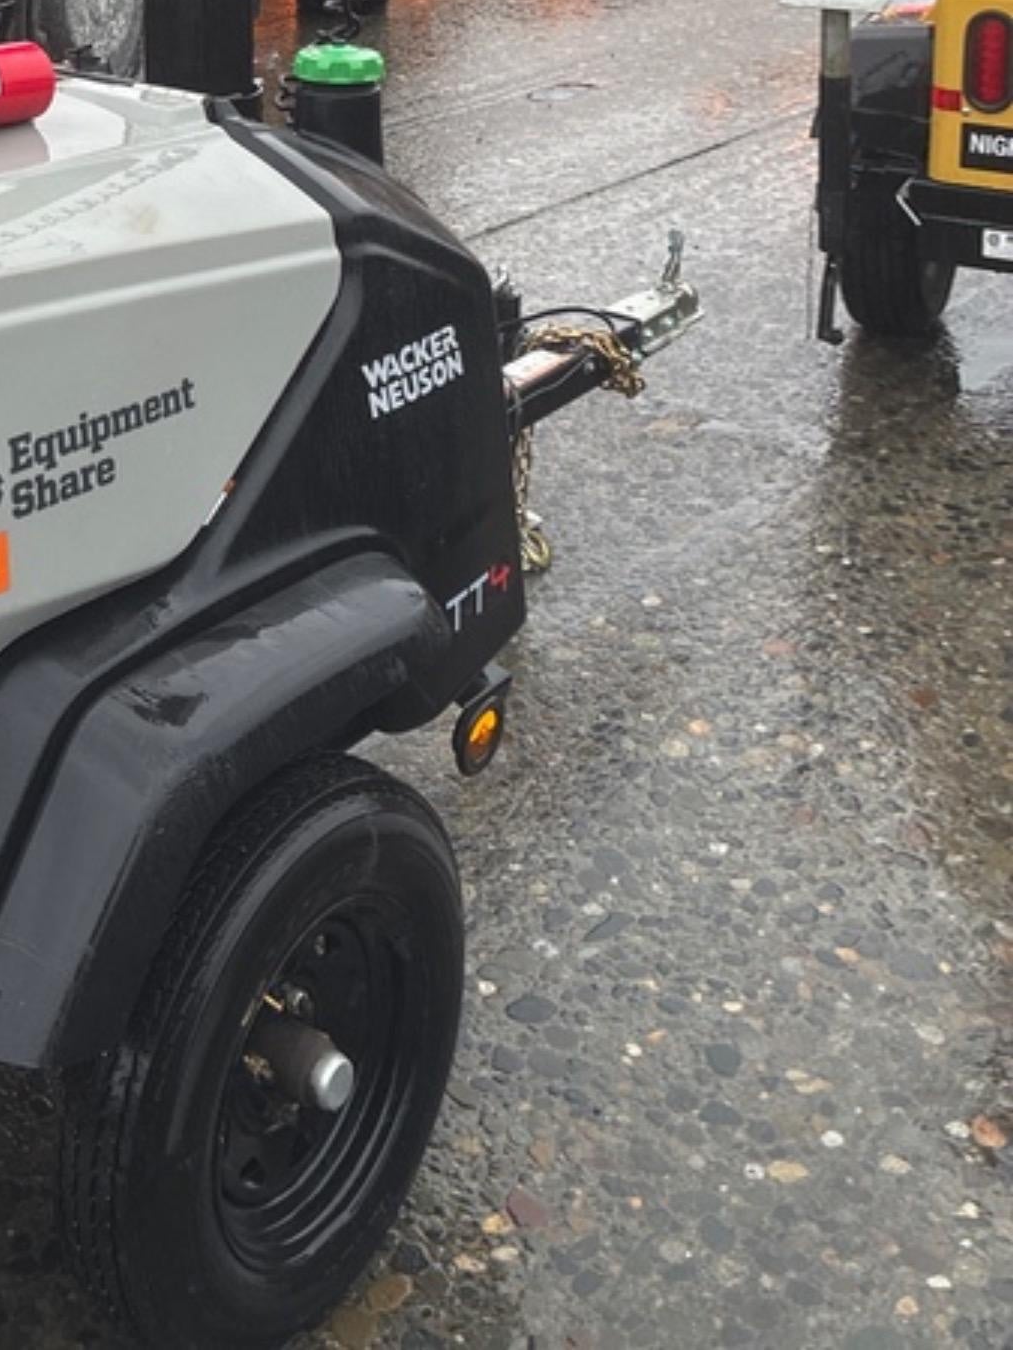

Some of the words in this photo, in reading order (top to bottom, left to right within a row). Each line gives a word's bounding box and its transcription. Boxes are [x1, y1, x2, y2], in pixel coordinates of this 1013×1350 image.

[361, 324, 459, 389] WACKER
[368, 350, 464, 419] NEUSON
[7, 378, 196, 474] Equipment
[10, 456, 117, 519] Share
